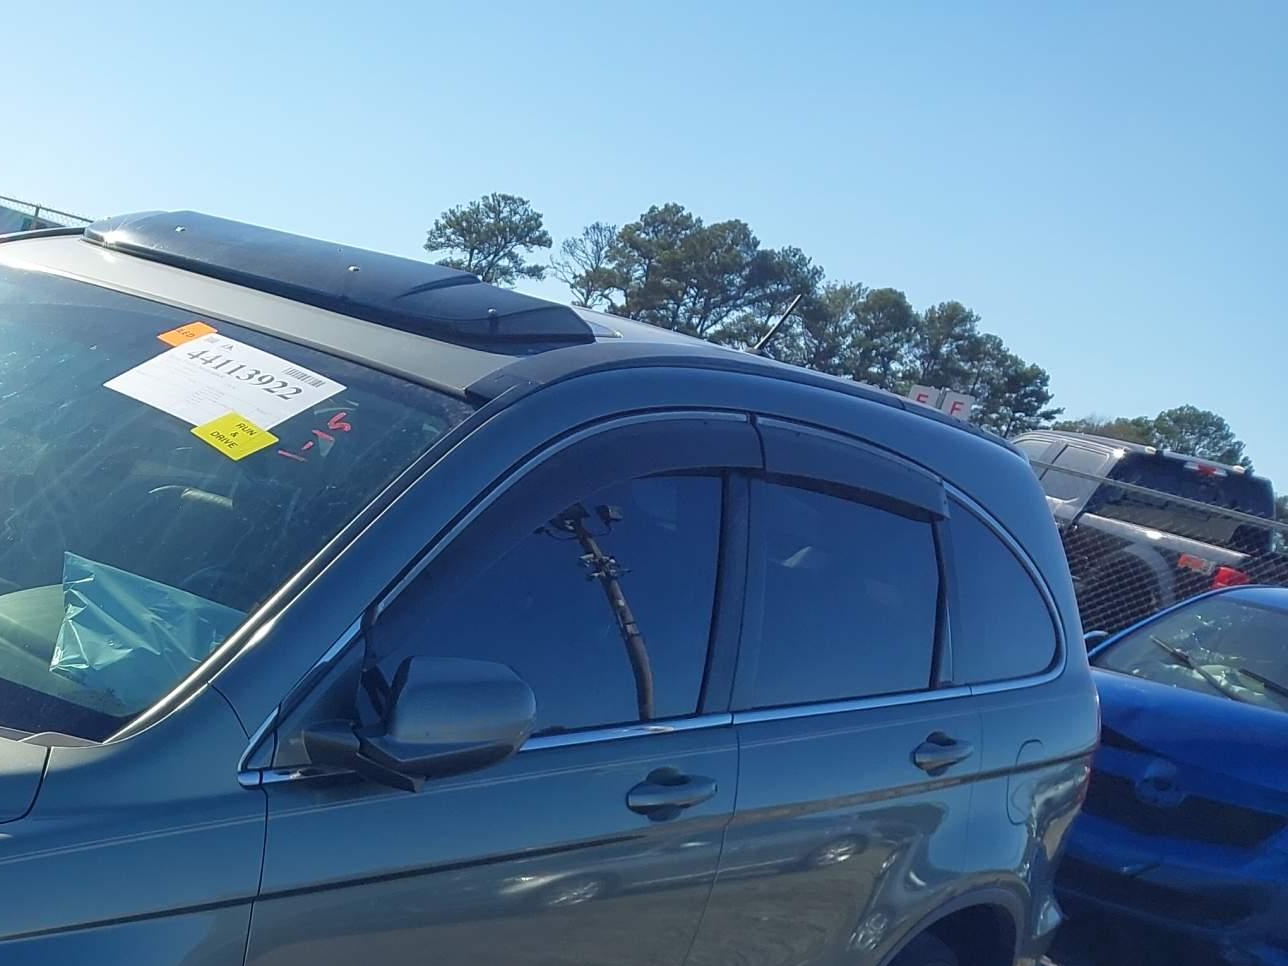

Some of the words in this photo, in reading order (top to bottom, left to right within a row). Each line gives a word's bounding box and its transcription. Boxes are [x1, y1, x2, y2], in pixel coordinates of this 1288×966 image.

[187, 350, 302, 400] 44113922
[236, 422, 257, 436] RUN
[210, 431, 239, 449] DRIVE
